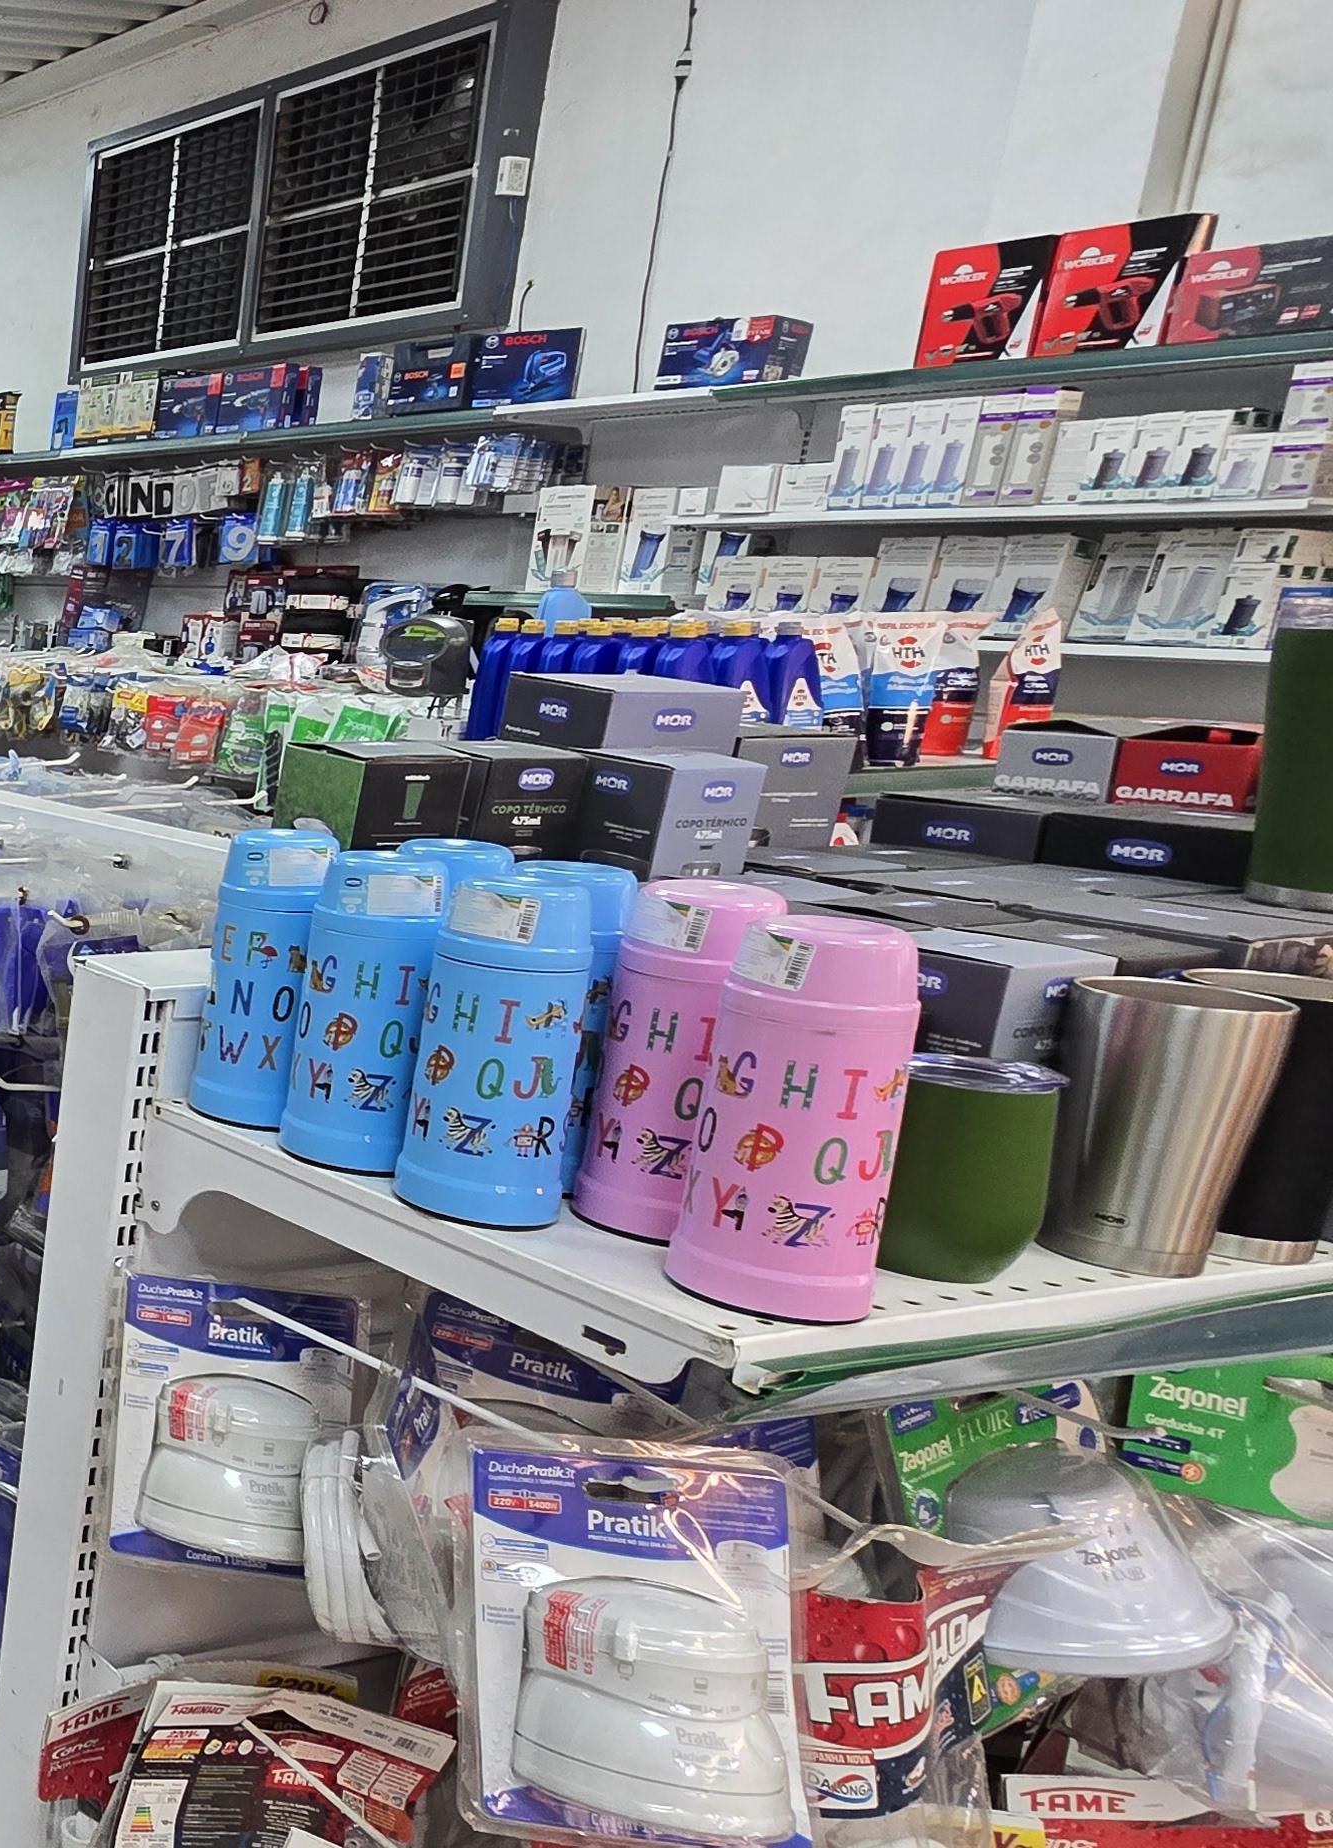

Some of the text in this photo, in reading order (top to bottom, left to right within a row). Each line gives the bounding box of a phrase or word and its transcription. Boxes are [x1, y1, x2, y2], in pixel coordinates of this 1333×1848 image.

[1062, 254, 1117, 271] WORKER
[939, 270, 989, 287] WORKER
[1189, 267, 1249, 285] WORKER
[504, 334, 547, 345] BOSCH
[403, 370, 429, 381] BOSCH
[130, 482, 153, 517] N
[155, 482, 175, 515] D
[93, 533, 106, 559] 1
[116, 535, 133, 568] 2
[167, 531, 186, 566] 7
[223, 526, 256, 562] 9
[892, 646, 926, 660] HTH
[1025, 644, 1050, 658] HTH
[539, 703, 568, 719] MOR
[655, 713, 692, 728] MOR
[782, 750, 812, 765] MOR
[1034, 749, 1070, 764] MOR
[1160, 759, 1198, 775] MOR
[520, 772, 552, 788] MOR
[595, 774, 629, 792] MOR
[995, 773, 1101, 796] GARRAFA
[702, 785, 733, 799] MOR
[1115, 786, 1234, 808] GARRAFA
[491, 801, 567, 815] COPO TÉRMICO
[674, 815, 748, 829] COPO TÉRMICO
[925, 826, 971, 843] MOR
[1111, 843, 1165, 863] MOR
[230, 979, 295, 1023] N O
[451, 990, 522, 1046] H I
[379, 1020, 404, 1059] Q
[646, 1008, 678, 1054] H
[257, 1035, 286, 1071] X
[476, 1058, 505, 1101] Q
[780, 1060, 819, 1111] H
[836, 1069, 868, 1120] I
[674, 1077, 705, 1121] Q
[813, 1137, 848, 1186] Q
[208, 1321, 264, 1346] Pratik
[510, 1351, 574, 1384] Pratik
[1149, 1375, 1249, 1418] Zagonel
[956, 1409, 1013, 1448] FLUIR
[1144, 1412, 1227, 1440] Gorducha 4T
[898, 1434, 953, 1473] Zagonel
[587, 1509, 668, 1539] Pratik
[186, 1550, 222, 1564] Contém
[57, 1701, 124, 1735] FAME
[846, 1754, 871, 1765] NOVA
[1030, 1792, 1128, 1815] FAME
